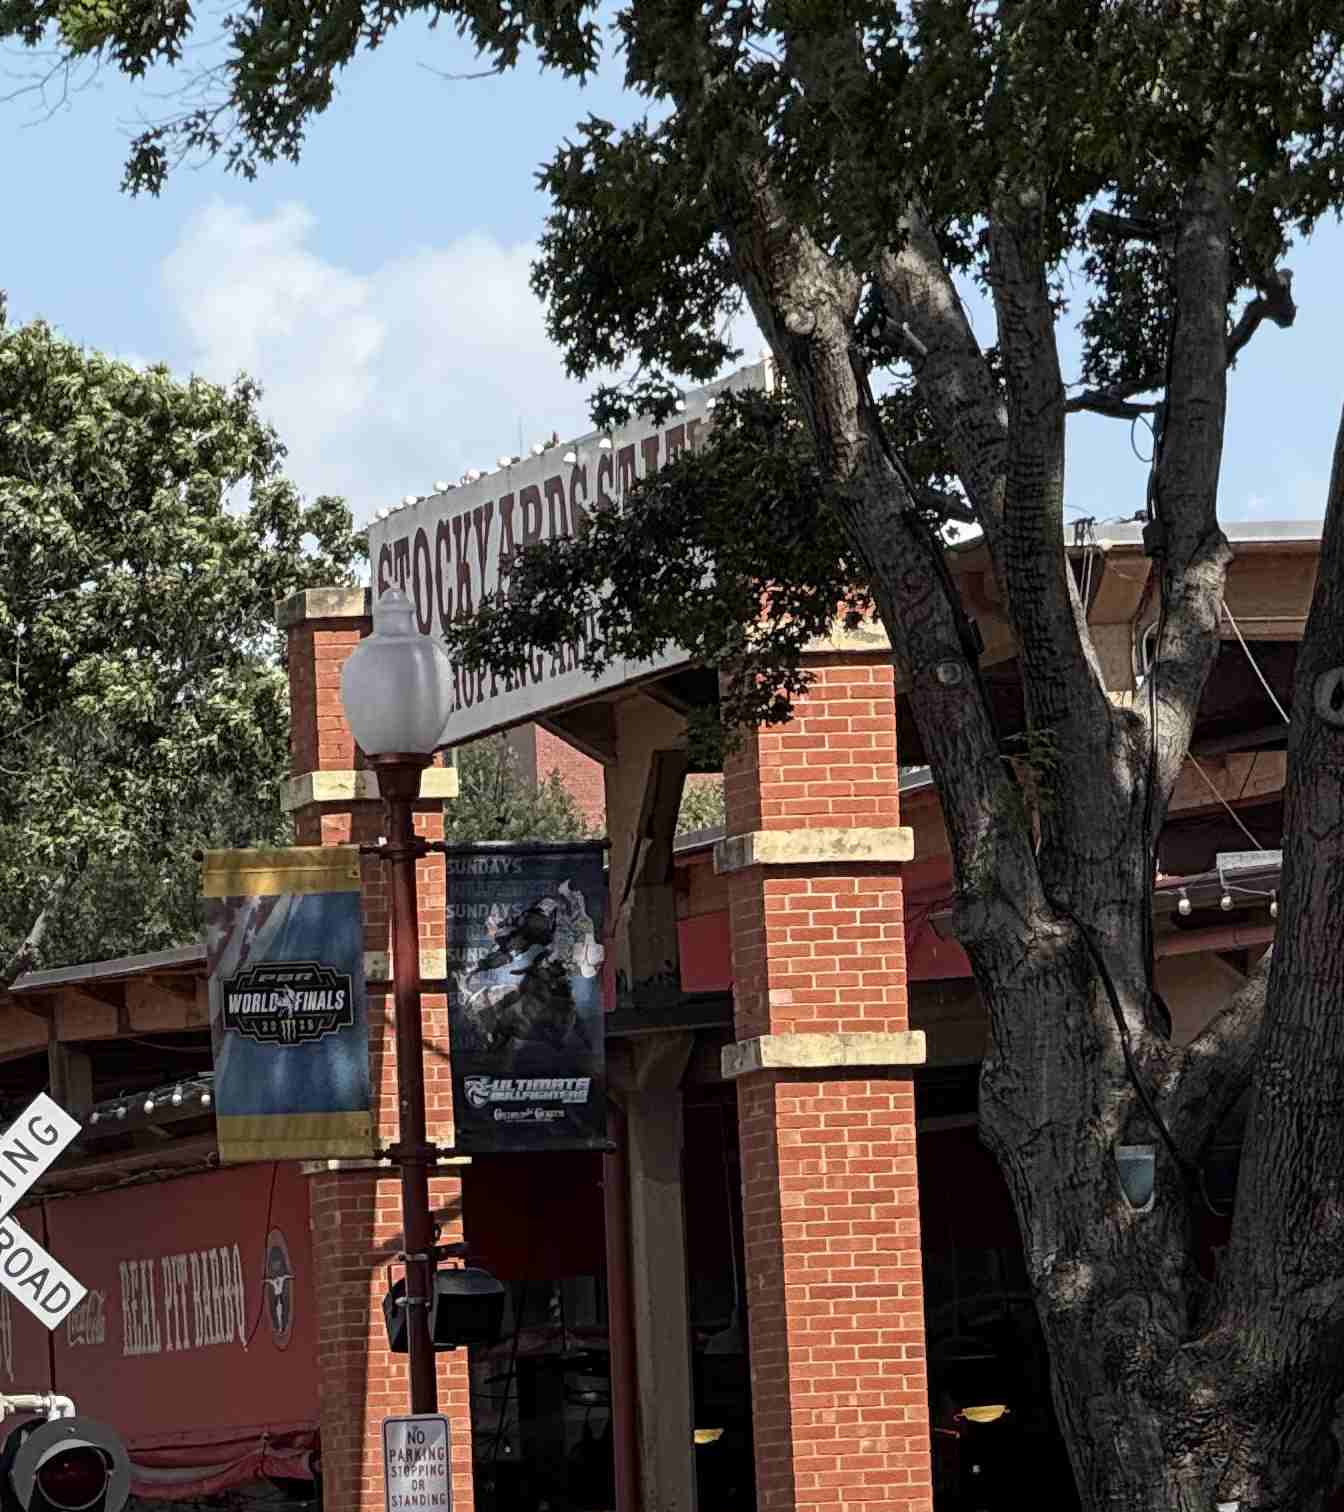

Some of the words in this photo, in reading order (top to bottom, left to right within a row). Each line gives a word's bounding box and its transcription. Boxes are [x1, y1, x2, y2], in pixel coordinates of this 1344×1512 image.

[446, 857, 522, 874] SUNDAYS
[228, 992, 278, 1014] WORLD
[294, 989, 345, 1012] FINALS
[118, 1259, 161, 1356] REAL
[162, 1253, 191, 1352] PIT
[407, 1430, 425, 1445] NO
[389, 1447, 445, 1463] PARKING
[391, 1463, 444, 1478] STOPPING
[411, 1479, 425, 1491] OR
[391, 1493, 446, 1508] STANDING
